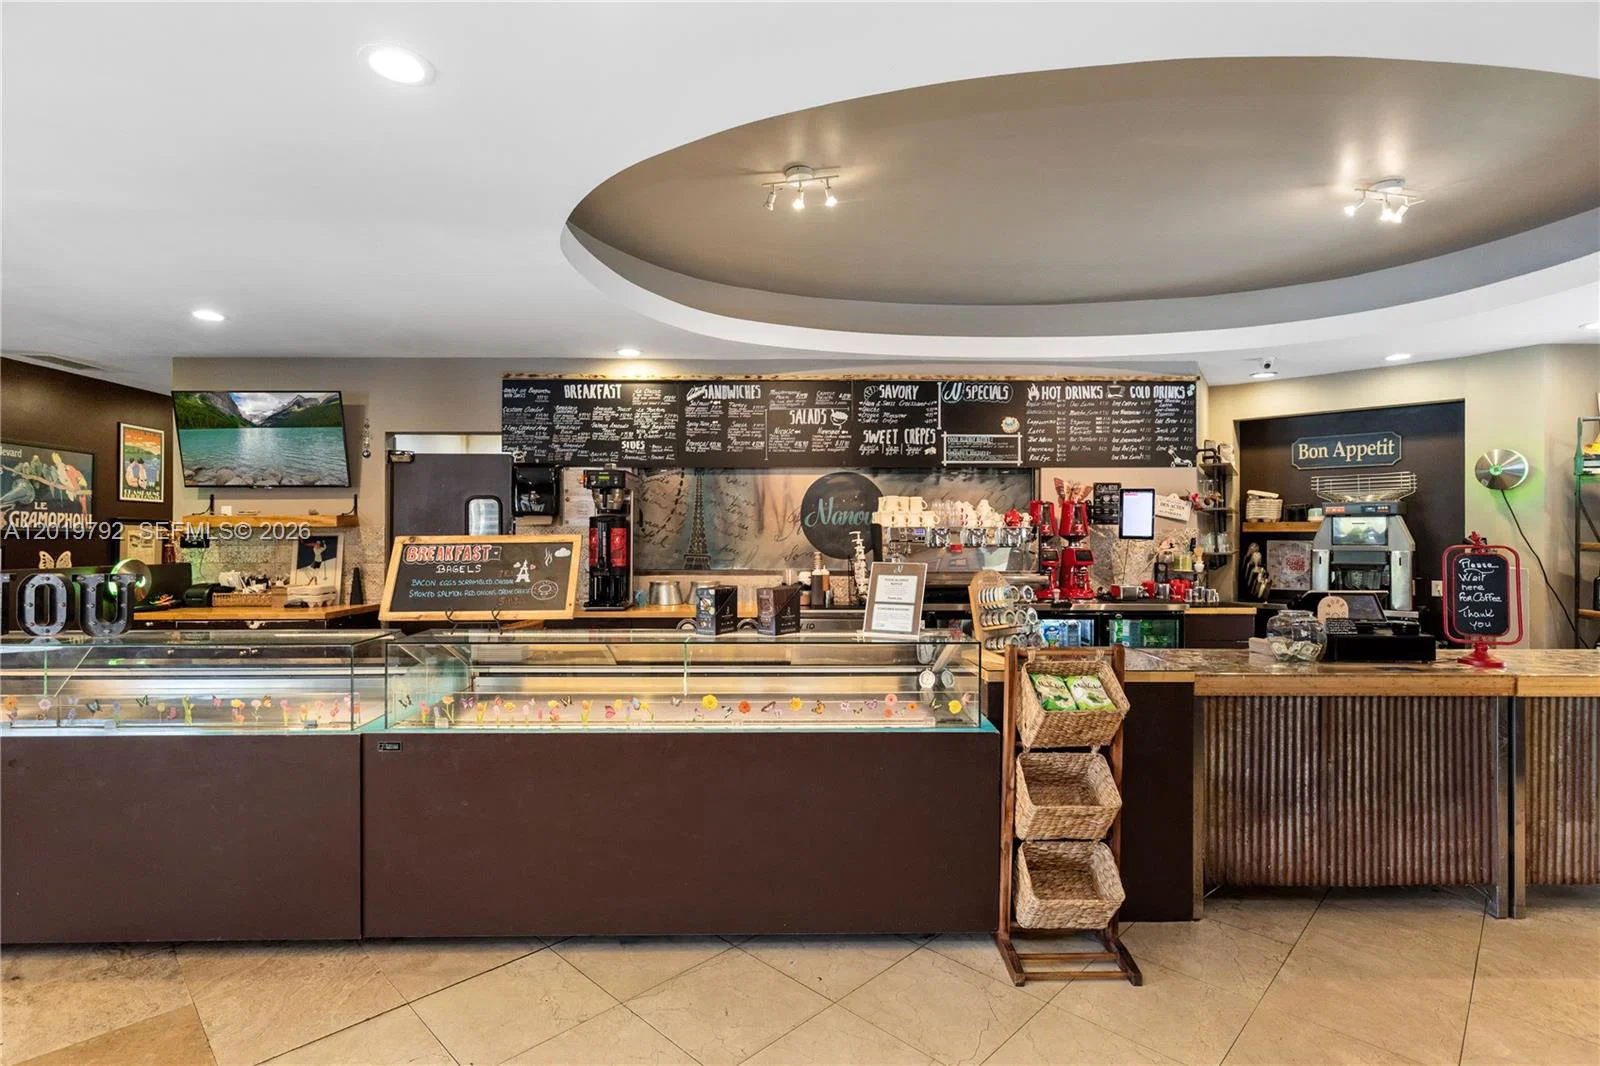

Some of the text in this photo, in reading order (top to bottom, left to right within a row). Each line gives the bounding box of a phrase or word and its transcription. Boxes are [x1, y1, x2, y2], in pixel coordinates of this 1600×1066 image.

[564, 384, 621, 399] BREAKFAST
[703, 385, 761, 399] SANDWICHES
[880, 385, 919, 400] SAVORY
[966, 385, 1009, 400] SPECIALS
[1041, 385, 1103, 400] HOT DRINKS
[1130, 385, 1185, 399] COLD DRINKS
[789, 408, 827, 424] SALADS
[863, 429, 898, 444] SWEET
[621, 440, 645, 449] SIDES
[1298, 438, 1395, 462] Bon Appetit
[34, 502, 48, 510] LE
[405, 544, 491, 562] BREAKFAST
[436, 564, 482, 573] BAGELS
[1459, 557, 1499, 570] Please
[411, 578, 436, 587] BACON
[1458, 573, 1486, 582] Wait
[1473, 592, 1502, 602] Coffee
[0, 573, 136, 637] OU
[1459, 606, 1495, 618] Thank
[1469, 621, 1492, 630] you
